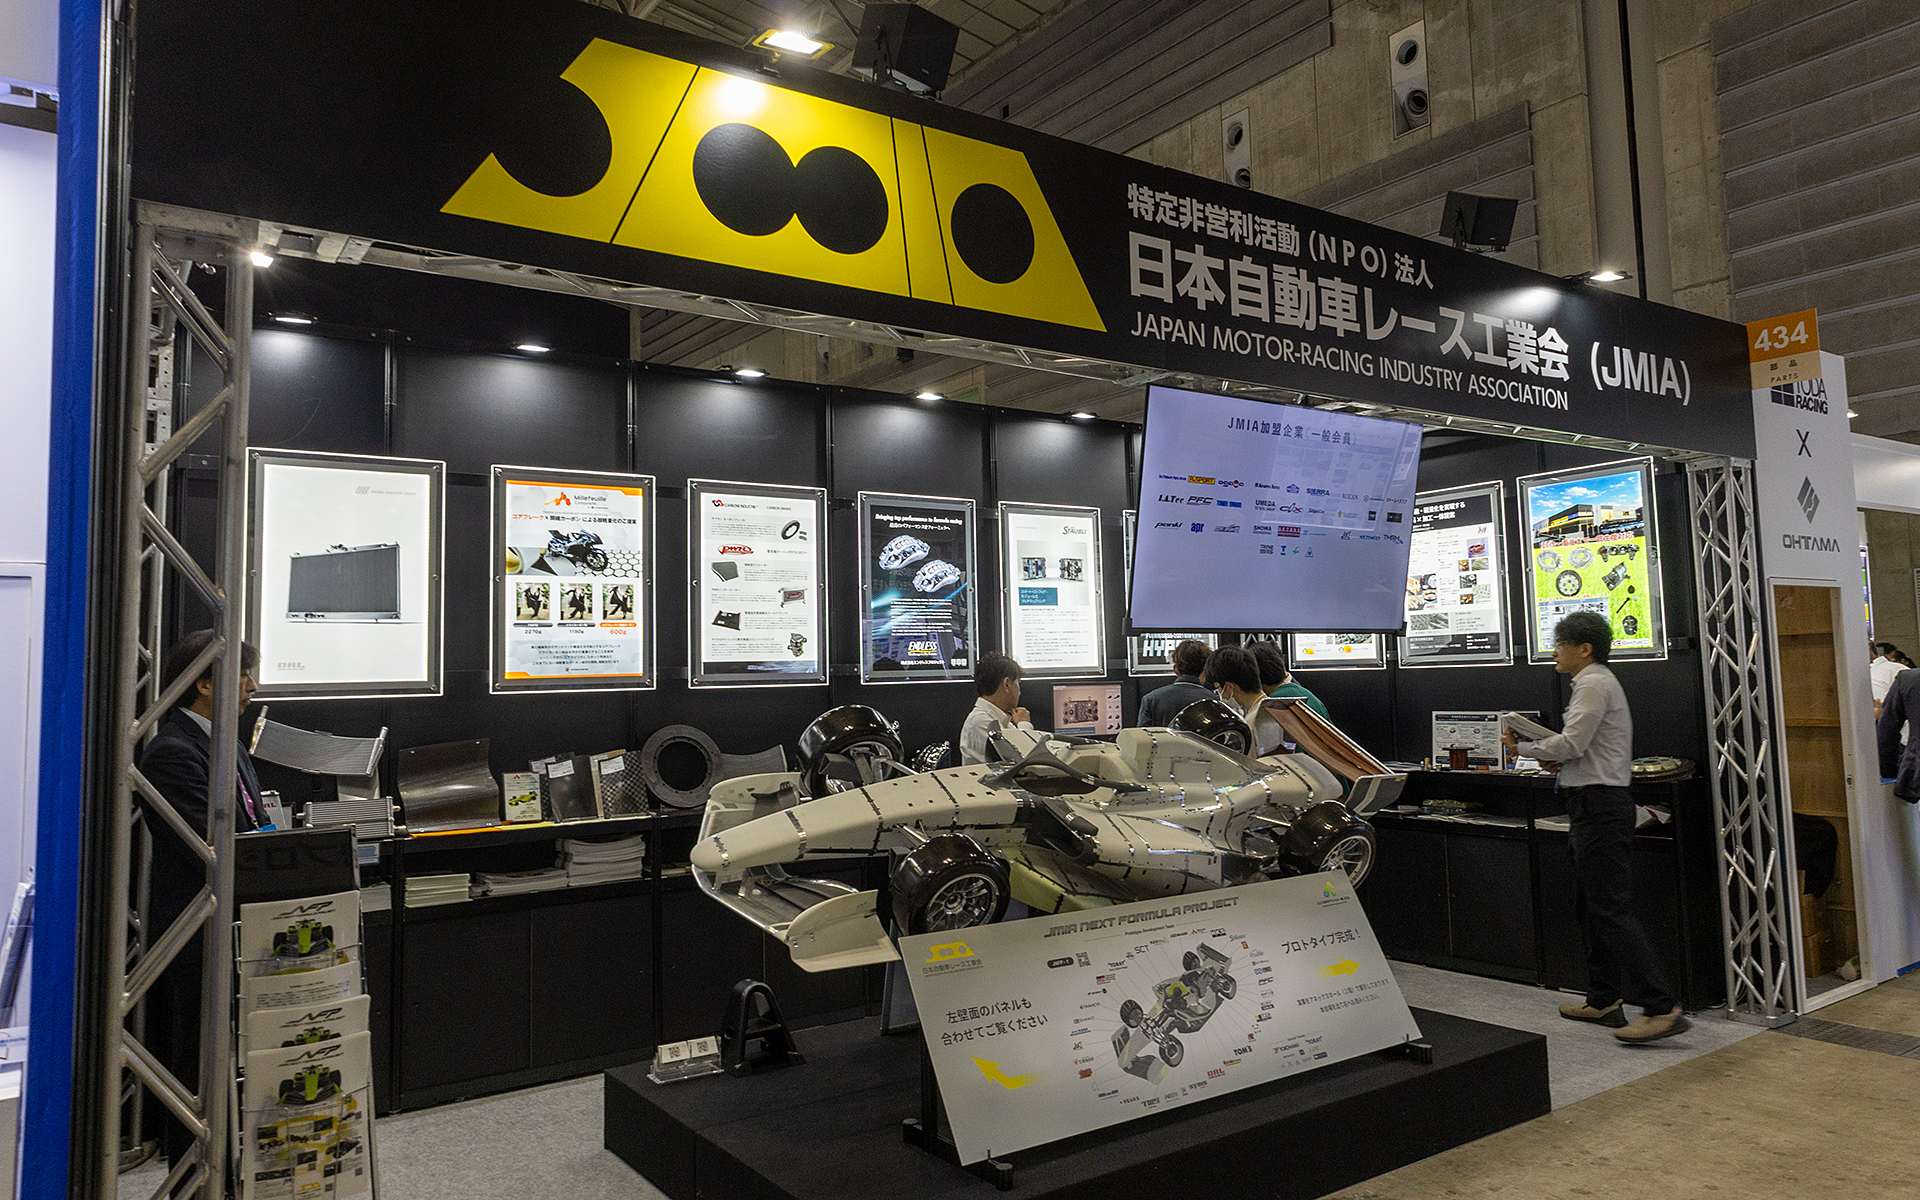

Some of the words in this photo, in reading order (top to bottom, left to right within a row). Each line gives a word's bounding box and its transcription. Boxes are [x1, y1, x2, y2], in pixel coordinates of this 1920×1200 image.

[1127, 183, 1300, 257] 特定非営利活動
[1394, 252, 1434, 290] 法人
[1129, 231, 1570, 382] 日本自動車レース工業会
[1591, 341, 1690, 406] (JMIA)
[1754, 321, 1808, 351] 434
[1131, 311, 1205, 348] JAPAN
[1213, 326, 1374, 377] MOTOR-RACING
[1380, 356, 1463, 392] INDUSTRY
[1468, 374, 1569, 411] ASSOCIATION
[1770, 372, 1799, 383] PARTS
[1796, 394, 1828, 414] RACING
[1191, 522, 1204, 533] apr
[610, 629, 627, 637] 600g
[908, 641, 938, 651] ENDLESS
[1044, 924, 1078, 938] JMIA
[1079, 917, 1116, 931] NEXT
[1117, 907, 1182, 925] FORMULA
[1183, 897, 1239, 915] PROJECT
[1134, 944, 1150, 955] SCT
[946, 998, 1032, 1024] 左壁面のパネルも
[941, 1015, 1049, 1046] 合わせてご覧ください
[1234, 1046, 1253, 1056] TOM'S
[1207, 1068, 1225, 1077] DRL
